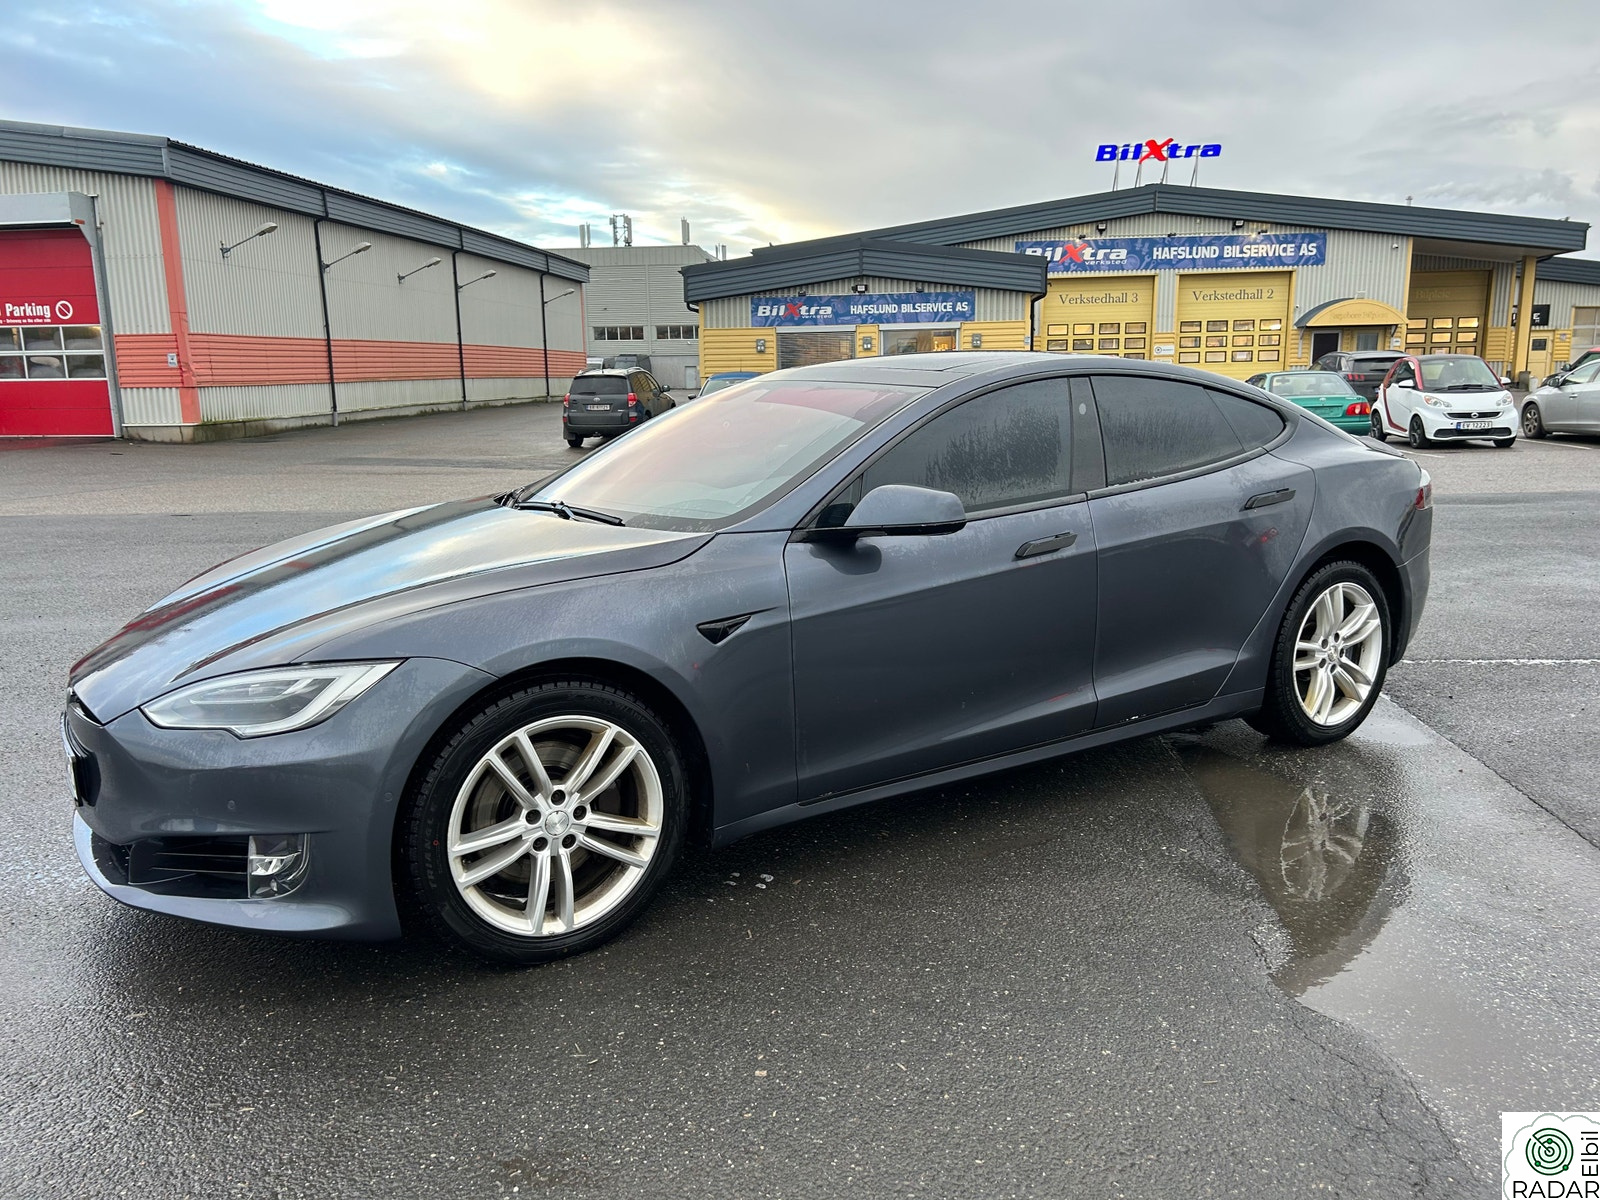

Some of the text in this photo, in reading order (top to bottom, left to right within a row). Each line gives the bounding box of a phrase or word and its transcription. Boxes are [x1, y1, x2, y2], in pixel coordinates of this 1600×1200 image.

[1095, 138, 1222, 164] BilXtra
[1153, 246, 1219, 260] HAFSLUND
[1223, 243, 1295, 258] BILSERVICE
[1299, 243, 1317, 256] AS
[1059, 292, 1139, 305] Verkstedhall 3
[1192, 289, 1274, 302] Verkstedhall 2
[5, 303, 51, 318] Parking
[757, 301, 968, 318] BilXtra HAFSLUND BILSERVICE AS
